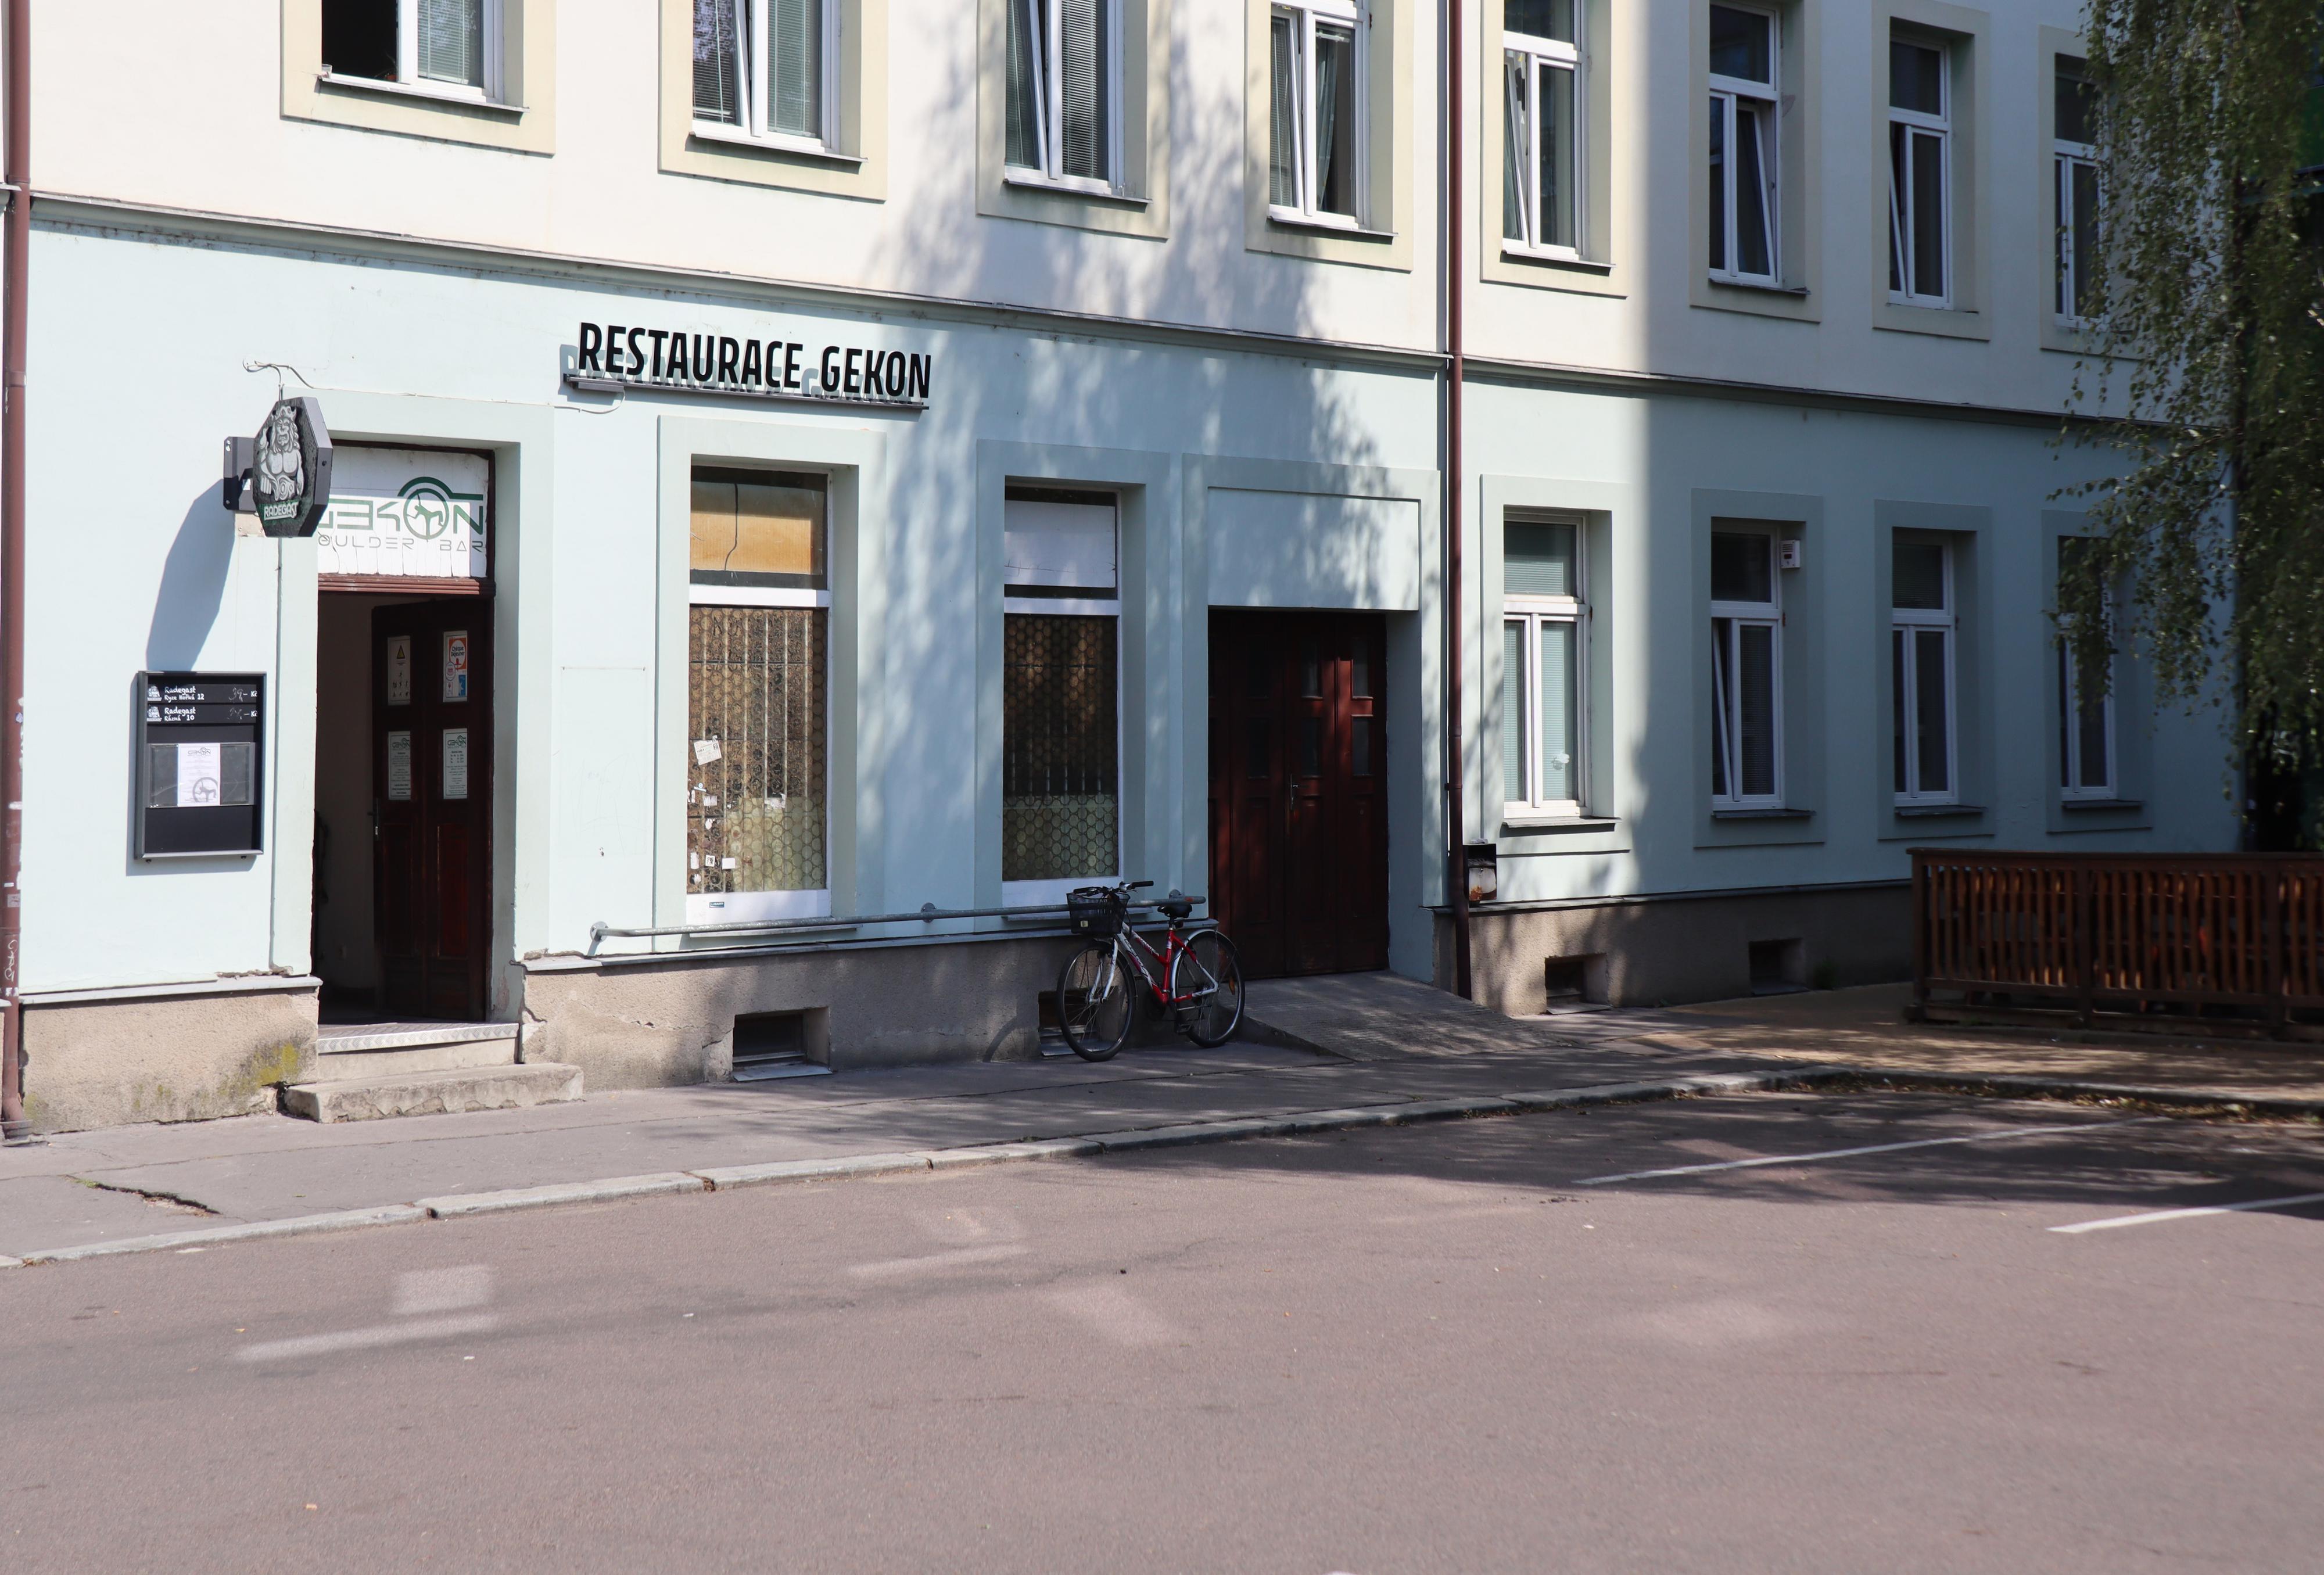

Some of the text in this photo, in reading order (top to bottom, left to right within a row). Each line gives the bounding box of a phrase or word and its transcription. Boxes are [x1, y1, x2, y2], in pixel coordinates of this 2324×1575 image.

[579, 321, 932, 399] RESTAURACE GEKON
[264, 501, 299, 521] RADEGAST
[440, 539, 483, 552] BAR
[164, 686, 196, 696] Radegast
[164, 706, 196, 716] Radegast
